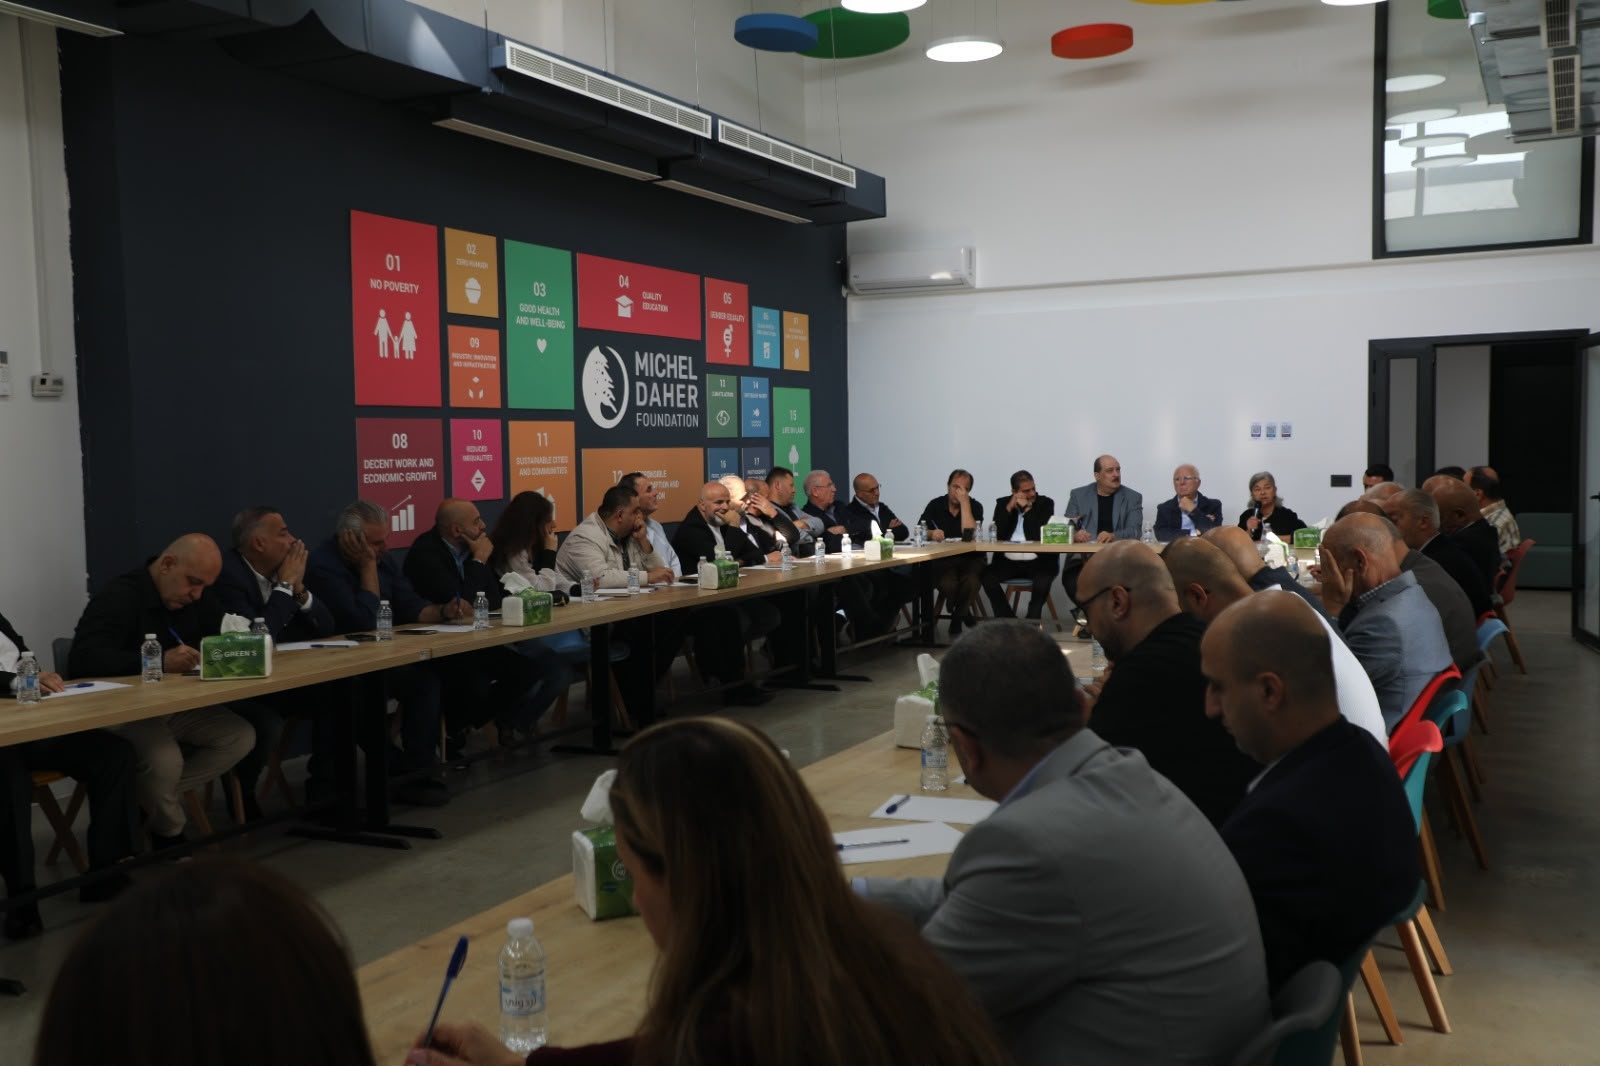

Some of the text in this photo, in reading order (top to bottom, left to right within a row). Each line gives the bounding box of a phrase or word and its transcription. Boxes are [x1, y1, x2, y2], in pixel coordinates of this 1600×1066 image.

[466, 243, 477, 255] 02
[386, 254, 400, 271] 01
[370, 278, 419, 294] NO POVERTY
[619, 274, 629, 288] 04
[533, 281, 546, 297] 03
[642, 291, 662, 302] QUALITY
[723, 292, 732, 305] 05
[519, 303, 560, 317] GOOD HEALTH
[642, 302, 668, 313] EDUCATION
[516, 315, 565, 329] AND WELL-BEING
[469, 337, 480, 348] 09
[635, 350, 698, 380] MICHEL
[635, 381, 698, 408] DAHER
[636, 412, 699, 427] FOUNDATION
[790, 410, 798, 421] 15
[391, 433, 408, 449] 08
[472, 429, 482, 440] 10
[537, 432, 548, 447] 11
[363, 458, 434, 470] DECENT WORK AND
[516, 455, 568, 465] SUSTAINABLE CITIES
[363, 471, 437, 484] ECONOMIC GROWTH
[519, 466, 567, 476] AND COMMUNITIES
[612, 470, 623, 484] 12
